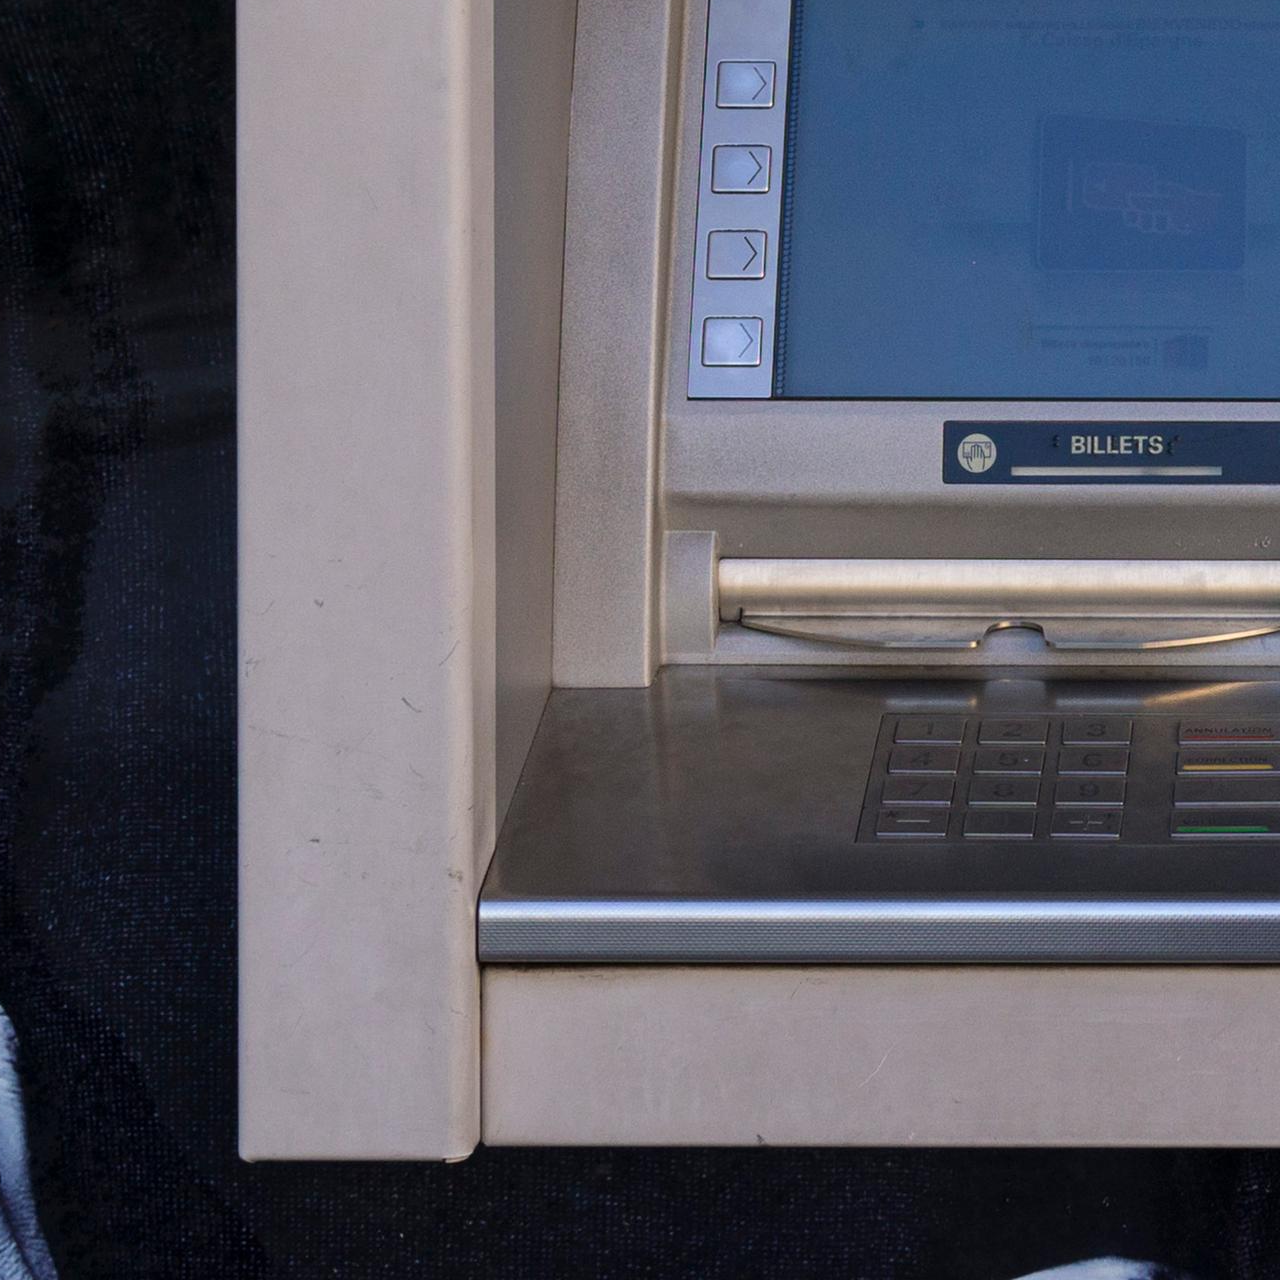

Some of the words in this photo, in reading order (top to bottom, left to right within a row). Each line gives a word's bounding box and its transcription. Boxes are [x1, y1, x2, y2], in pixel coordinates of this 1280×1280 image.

[1071, 435, 1164, 455] BILLETS
[1087, 723, 1107, 737] 3
[999, 752, 1019, 766] 5
